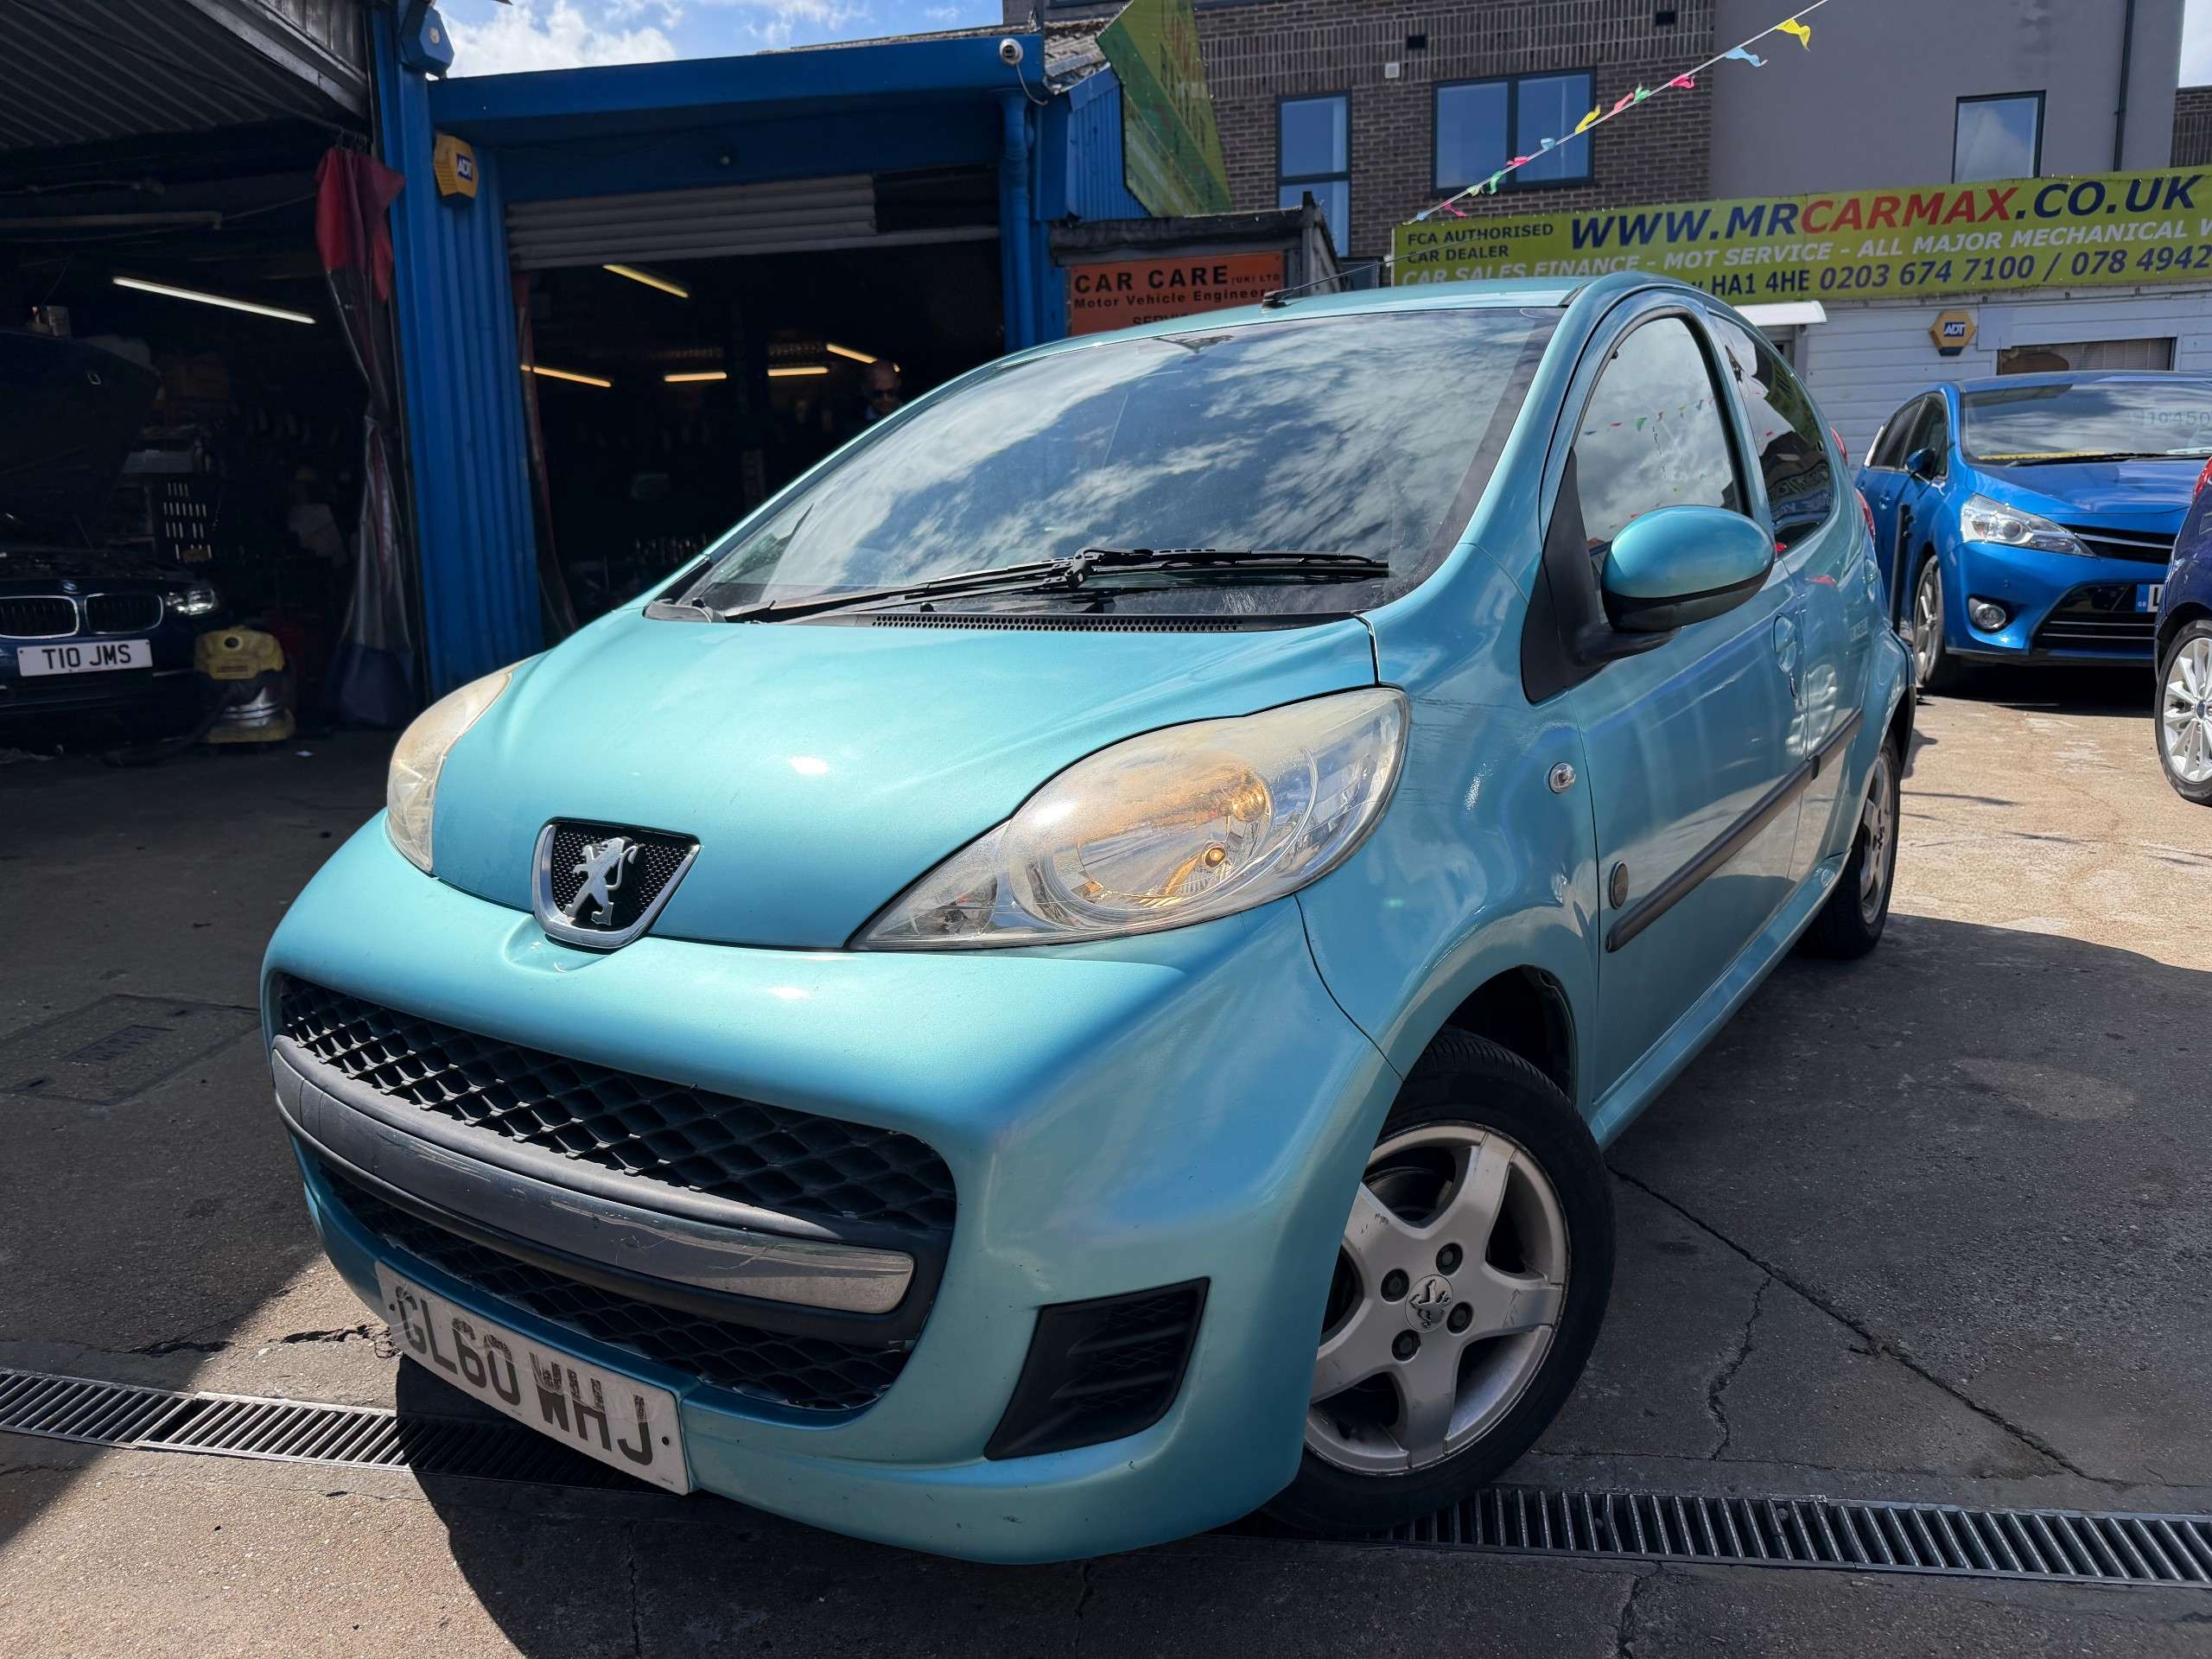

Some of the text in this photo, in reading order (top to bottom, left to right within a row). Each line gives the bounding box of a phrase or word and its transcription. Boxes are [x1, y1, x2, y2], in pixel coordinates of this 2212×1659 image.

[1572, 174, 2204, 250] WWW.MRCARMAX.CO.UK
[1408, 223, 1554, 245] FCA AUTHORISED
[1402, 265, 1453, 285] CAR
[1455, 261, 1528, 280] SALES
[1532, 255, 1639, 277] FINANCE
[1663, 250, 1724, 270] MOT
[1725, 242, 1834, 268] SERVICE
[1857, 238, 1904, 257] ALL
[1911, 231, 2003, 254] MAJOR
[2010, 219, 2189, 248] MECHANICAL
[1408, 245, 1510, 264] CAR DEALER
[1074, 272, 1134, 294] CAR
[1147, 265, 1229, 289] CARE
[1260, 274, 1280, 283] LTD
[1711, 273, 1756, 296] HA1
[1764, 270, 1810, 293] 4HE
[1819, 264, 1890, 289] 0203
[1899, 260, 1953, 285] 674
[1963, 255, 2034, 283] 7100
[2070, 249, 2127, 275] 078
[2136, 244, 2212, 272] 4942
[1073, 289, 1274, 310] Motor Vehicle Engineer
[1944, 323, 1966, 335] ADT
[90, 644, 131, 666] JMS
[395, 1286, 654, 1466] GL60 WHJ
